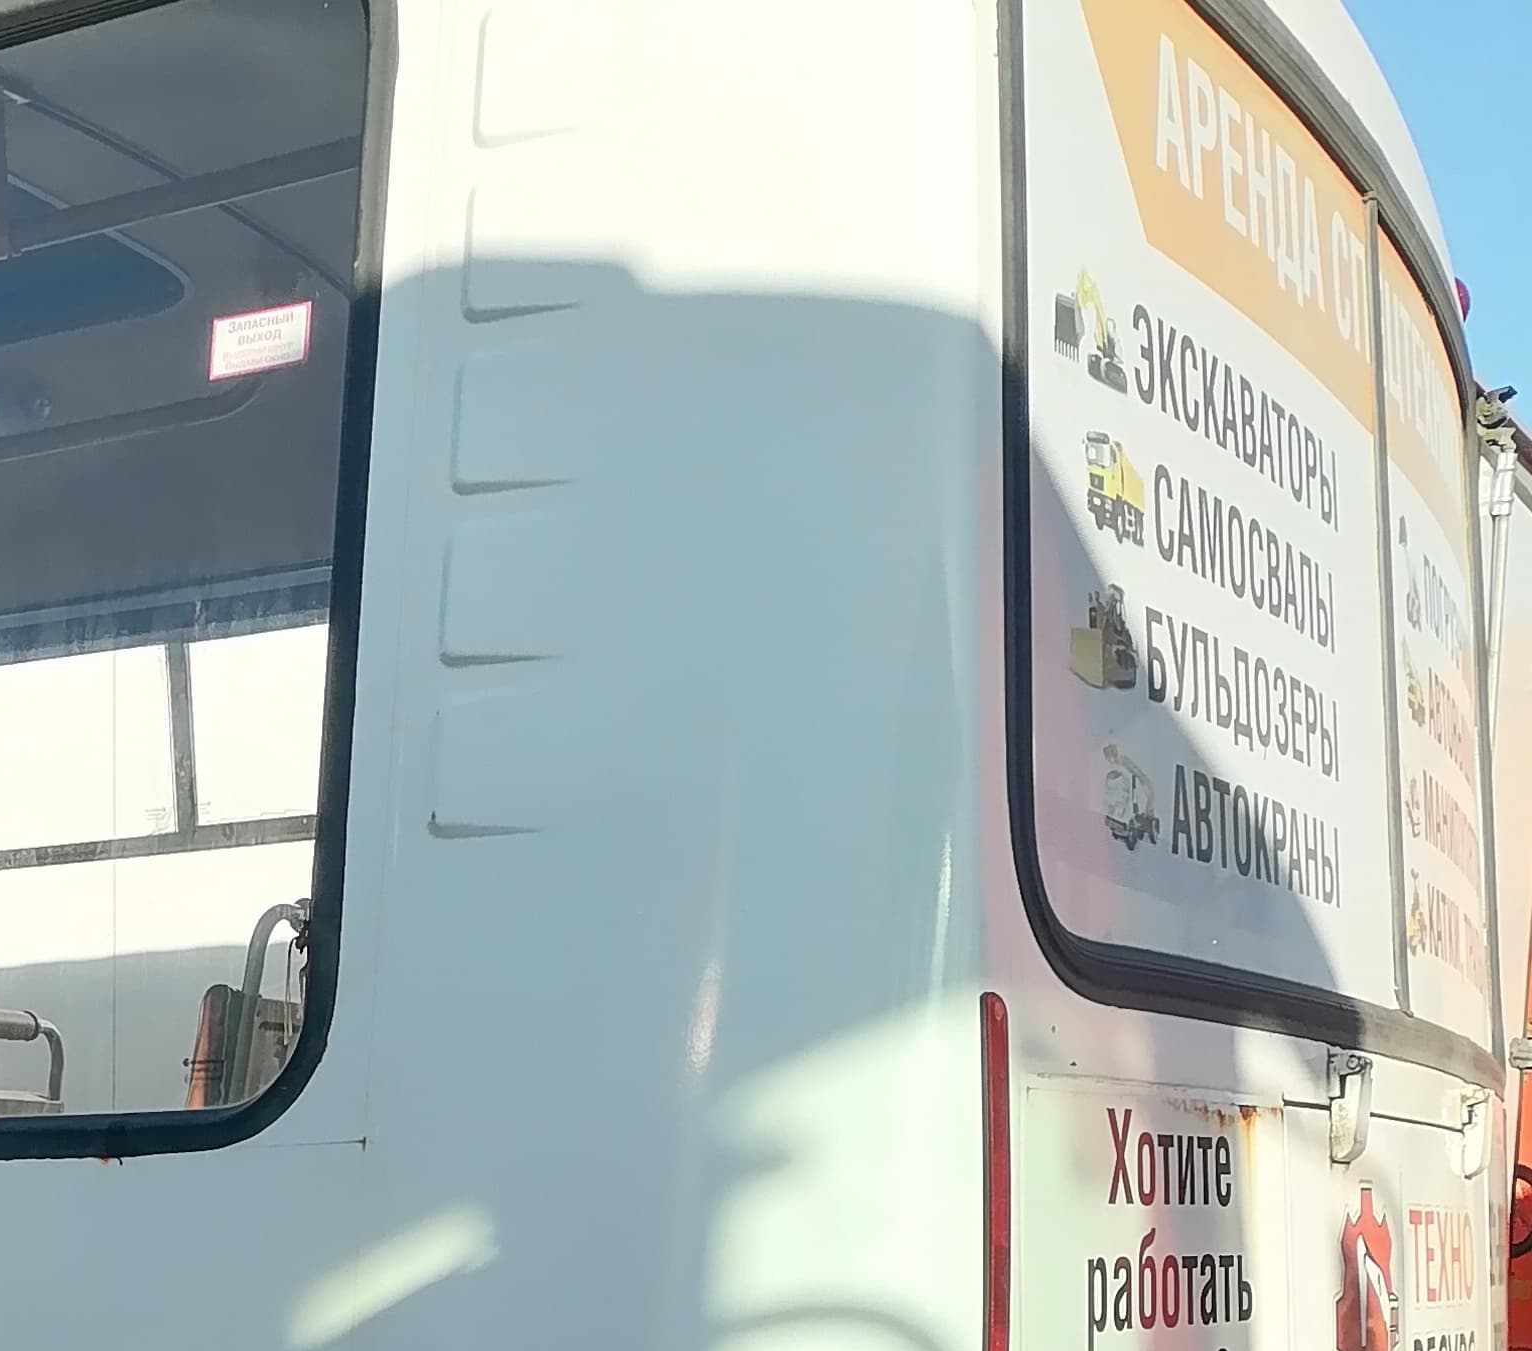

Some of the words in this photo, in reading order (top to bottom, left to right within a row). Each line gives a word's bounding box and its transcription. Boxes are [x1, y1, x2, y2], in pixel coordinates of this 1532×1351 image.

[1156, 33, 1325, 312] АРЕНДА
[237, 328, 282, 346] ВЫХОД
[1132, 304, 1338, 532] ЭКСКАВАТОРЫ
[1154, 463, 1335, 654] САМОСВАЛЫ
[1145, 606, 1340, 782] БУЛЬДОЗЕРЫ
[1171, 764, 1341, 908] АВТОКРАНЫ
[1107, 1107, 1232, 1207] Хотите
[1409, 1209, 1475, 1303] ТЕХНО
